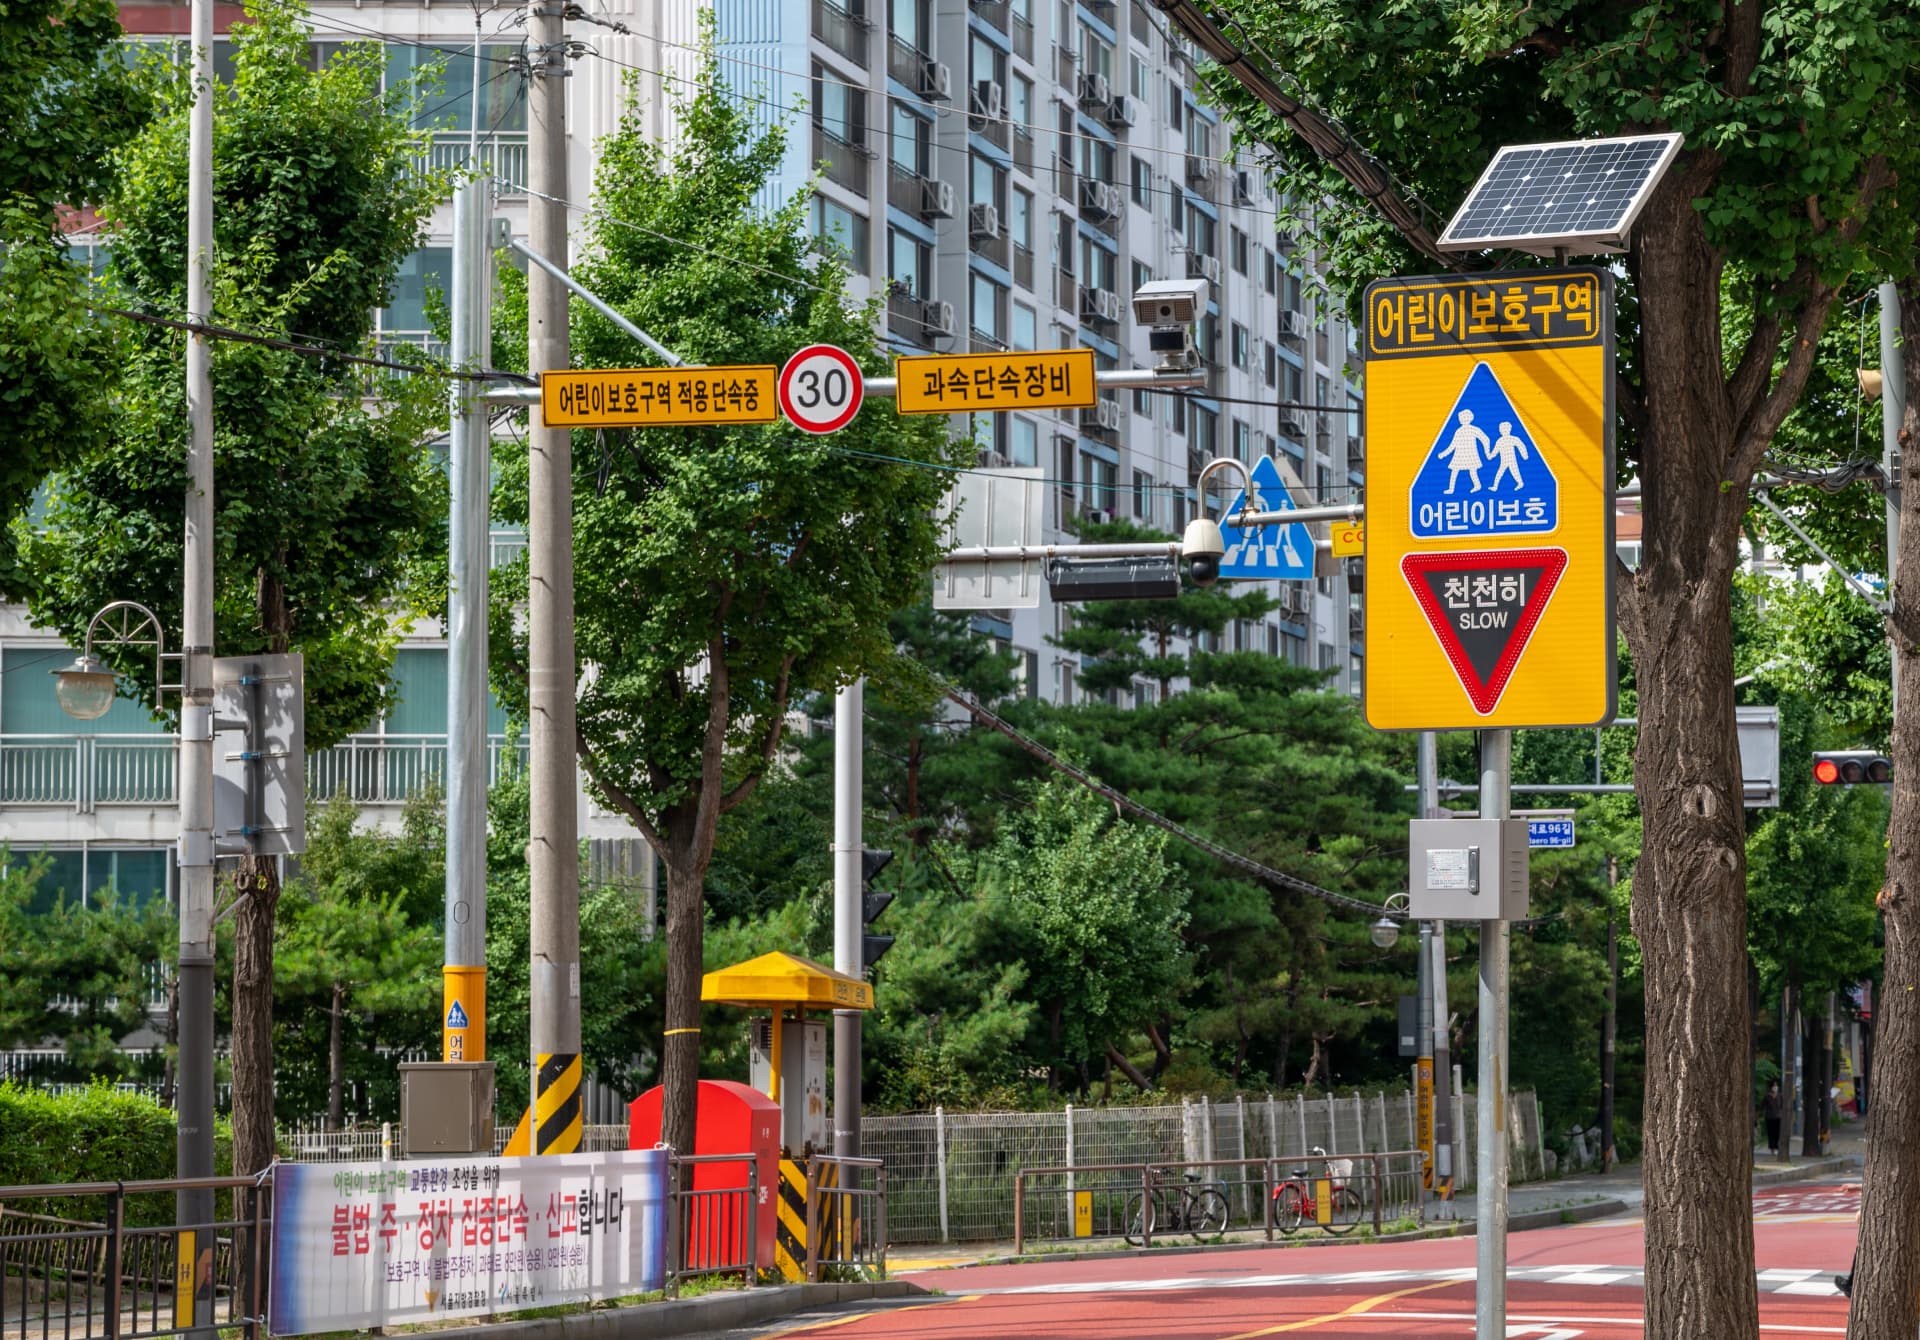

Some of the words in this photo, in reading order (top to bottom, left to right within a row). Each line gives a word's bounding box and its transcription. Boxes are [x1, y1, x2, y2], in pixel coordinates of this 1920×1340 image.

[1377, 280, 1592, 345] 어린이보호구역
[559, 380, 671, 416] 어린이보호구역
[797, 368, 847, 408] 30
[922, 361, 1071, 402] 과속단속장비
[1419, 496, 1549, 533] 어린이보호
[1443, 572, 1526, 609] 천천히
[1459, 612, 1508, 630] SLOW
[333, 1169, 363, 1198] 어린이
[368, 1168, 407, 1196] 보호구역
[411, 1167, 448, 1193] 교통환경
[452, 1165, 479, 1191] 조성을
[483, 1164, 501, 1191] 위해
[331, 1203, 370, 1256] 불법
